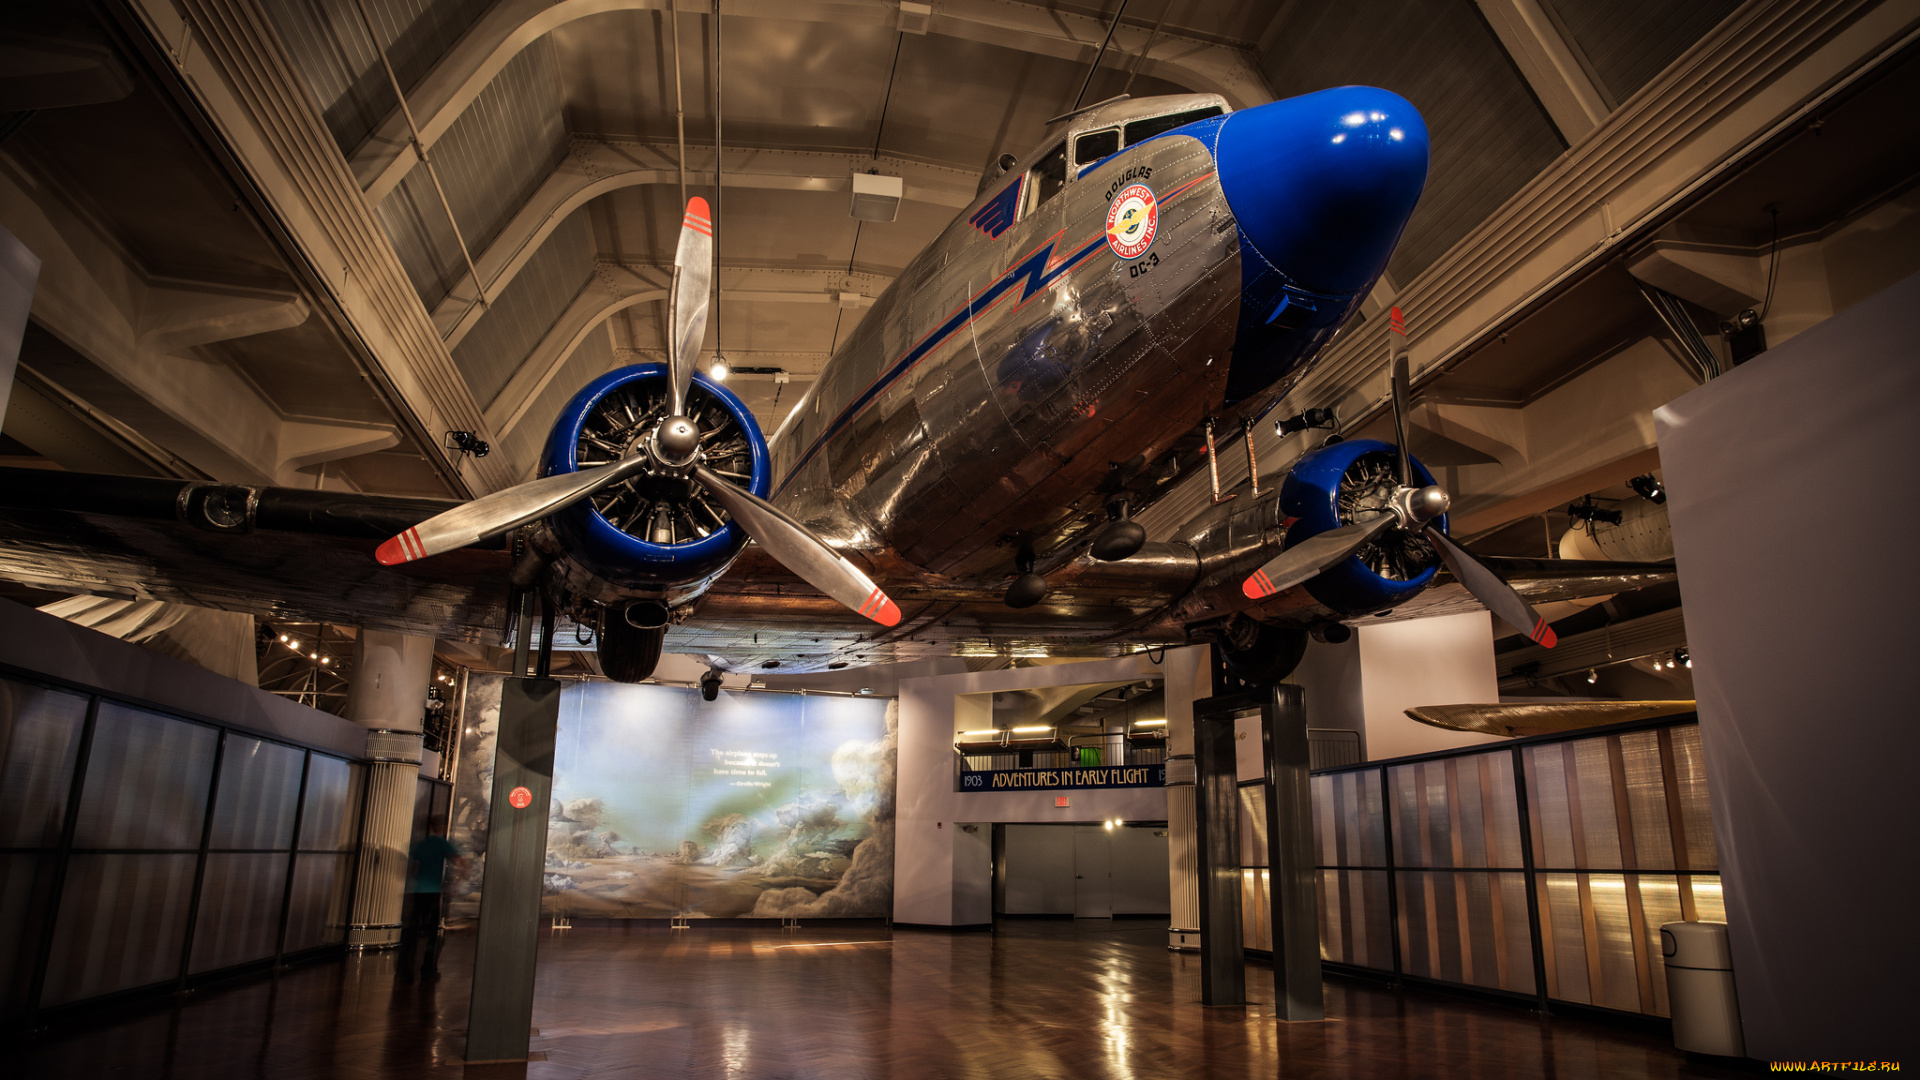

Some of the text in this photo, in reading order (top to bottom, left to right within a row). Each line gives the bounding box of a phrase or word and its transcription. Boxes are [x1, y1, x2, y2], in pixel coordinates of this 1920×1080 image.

[1105, 166, 1152, 202] DOUGLAS
[1109, 187, 1150, 223] NORTHWEST
[1112, 215, 1156, 256] AIRLINES INC.
[1129, 252, 1160, 278] DC-3
[710, 748, 724, 756] The
[725, 750, 752, 758] airplane
[964, 775, 983, 787] 1903
[992, 771, 1060, 788] ADVENTURES
[1061, 771, 1073, 786] IN
[1075, 769, 1108, 785] EARLY
[1111, 768, 1149, 784] FLIGHT
[1056, 796, 1067, 806] EXIT
